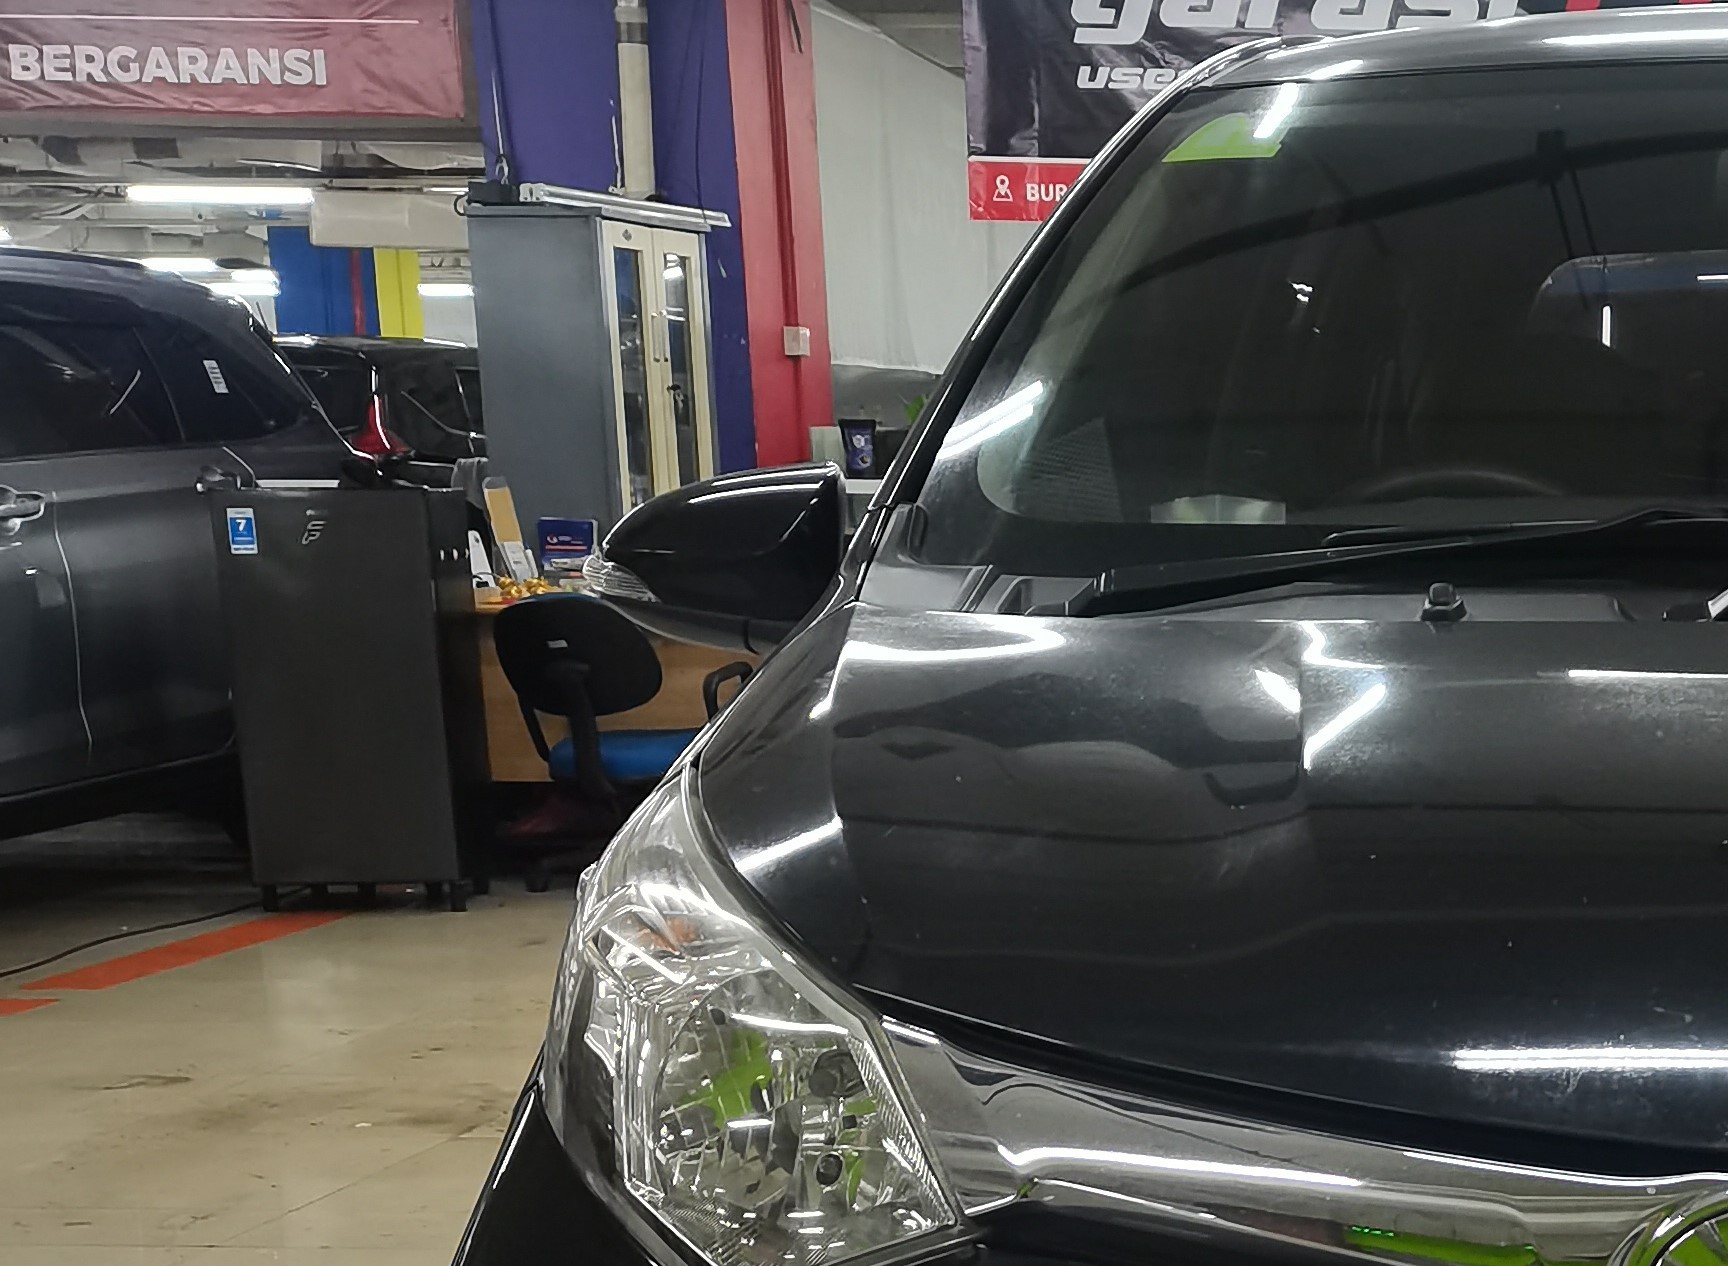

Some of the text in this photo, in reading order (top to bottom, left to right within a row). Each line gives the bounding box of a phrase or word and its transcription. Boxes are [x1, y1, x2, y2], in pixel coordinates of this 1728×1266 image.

[8, 43, 327, 85] BERGARANSI
[1076, 65, 1189, 90] use
[1026, 182, 1072, 202] BUR
